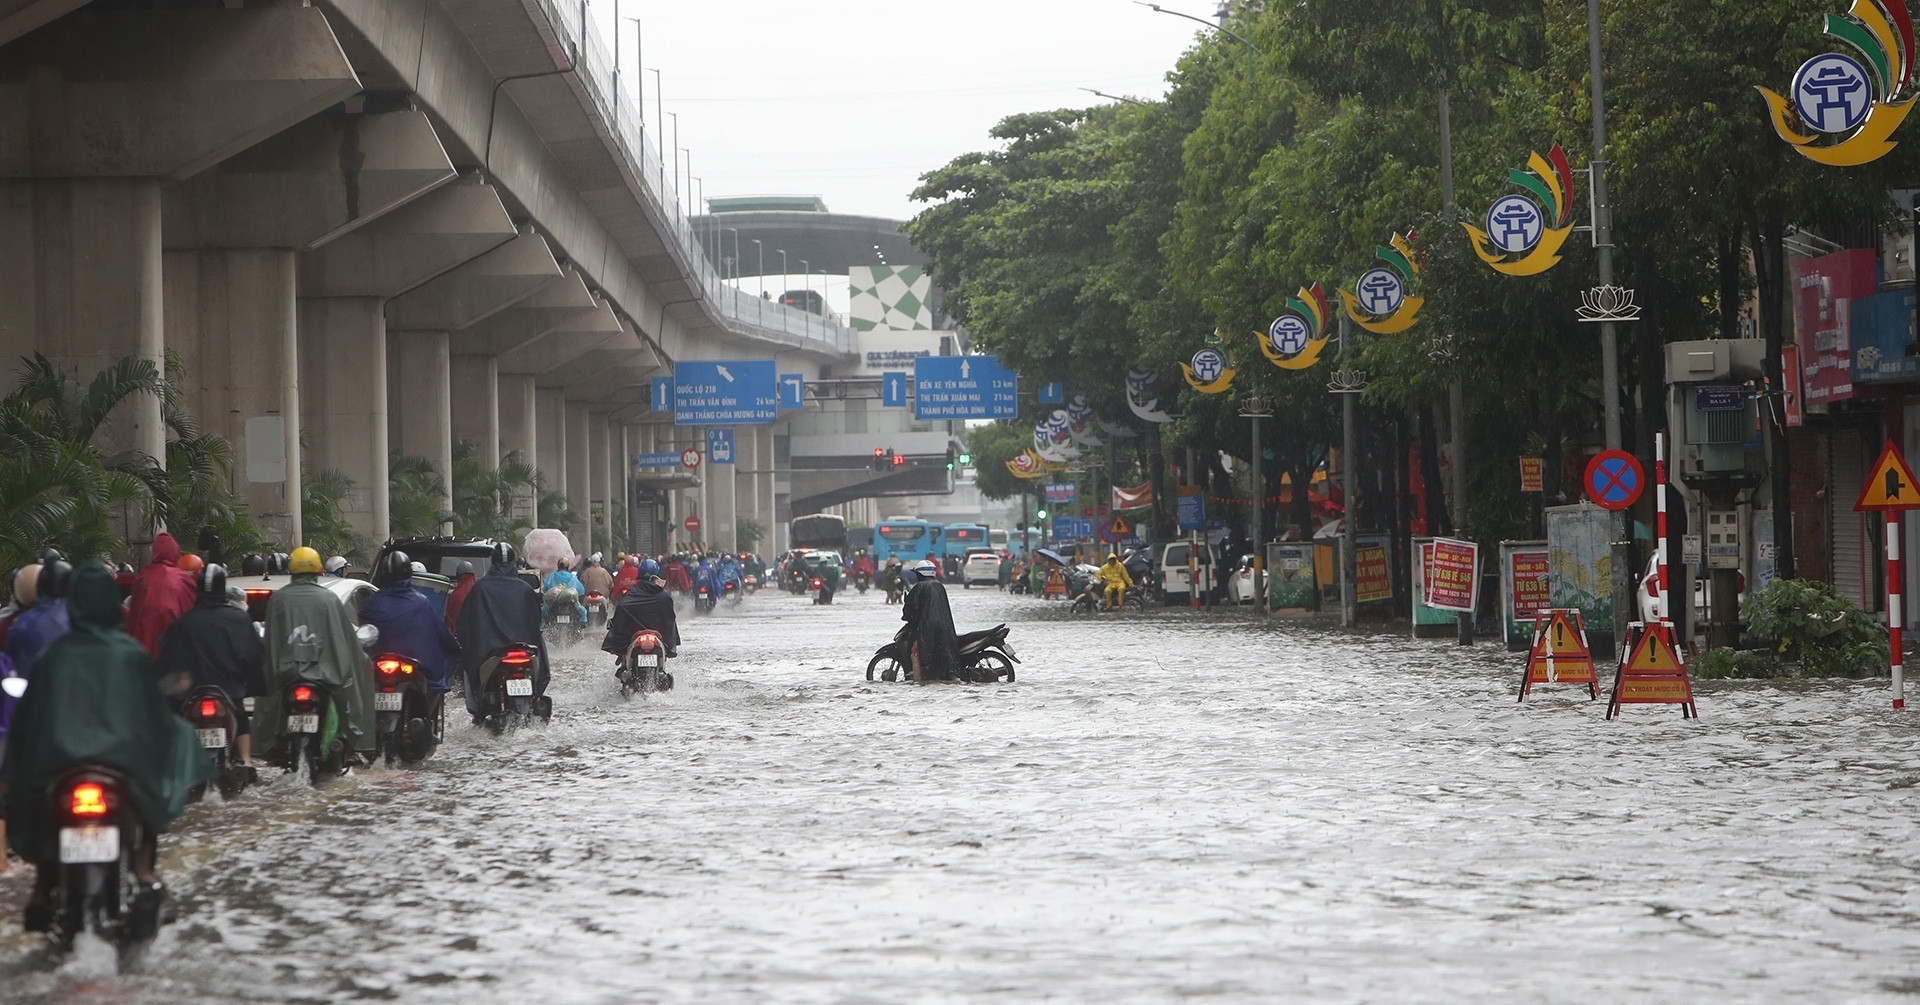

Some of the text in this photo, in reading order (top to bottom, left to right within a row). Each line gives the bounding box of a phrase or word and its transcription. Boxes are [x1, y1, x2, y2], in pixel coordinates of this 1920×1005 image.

[676, 384, 717, 394] QUỐC LỘ 21B
[919, 379, 932, 389] BẾN
[934, 381, 942, 389] XE
[944, 380, 956, 389] YÊN
[1003, 380, 1013, 388] km
[677, 399, 687, 408] THỊ
[689, 396, 705, 406] TRẤN
[756, 397, 764, 405] 26
[765, 397, 775, 405] km
[920, 394, 930, 403] THỊ
[932, 391, 949, 402] TRẤN
[950, 392, 968, 402] XUÂN
[968, 393, 981, 401] MAI
[1003, 393, 1013, 401] km
[676, 412, 694, 420] DANH
[716, 409, 732, 419] CHÙA
[765, 410, 775, 418] km
[920, 405, 941, 415] THÀNH
[942, 404, 955, 415] PHỐ
[970, 404, 985, 414] BÌNH
[1003, 405, 1013, 413] km
[893, 455, 903, 464] 37
